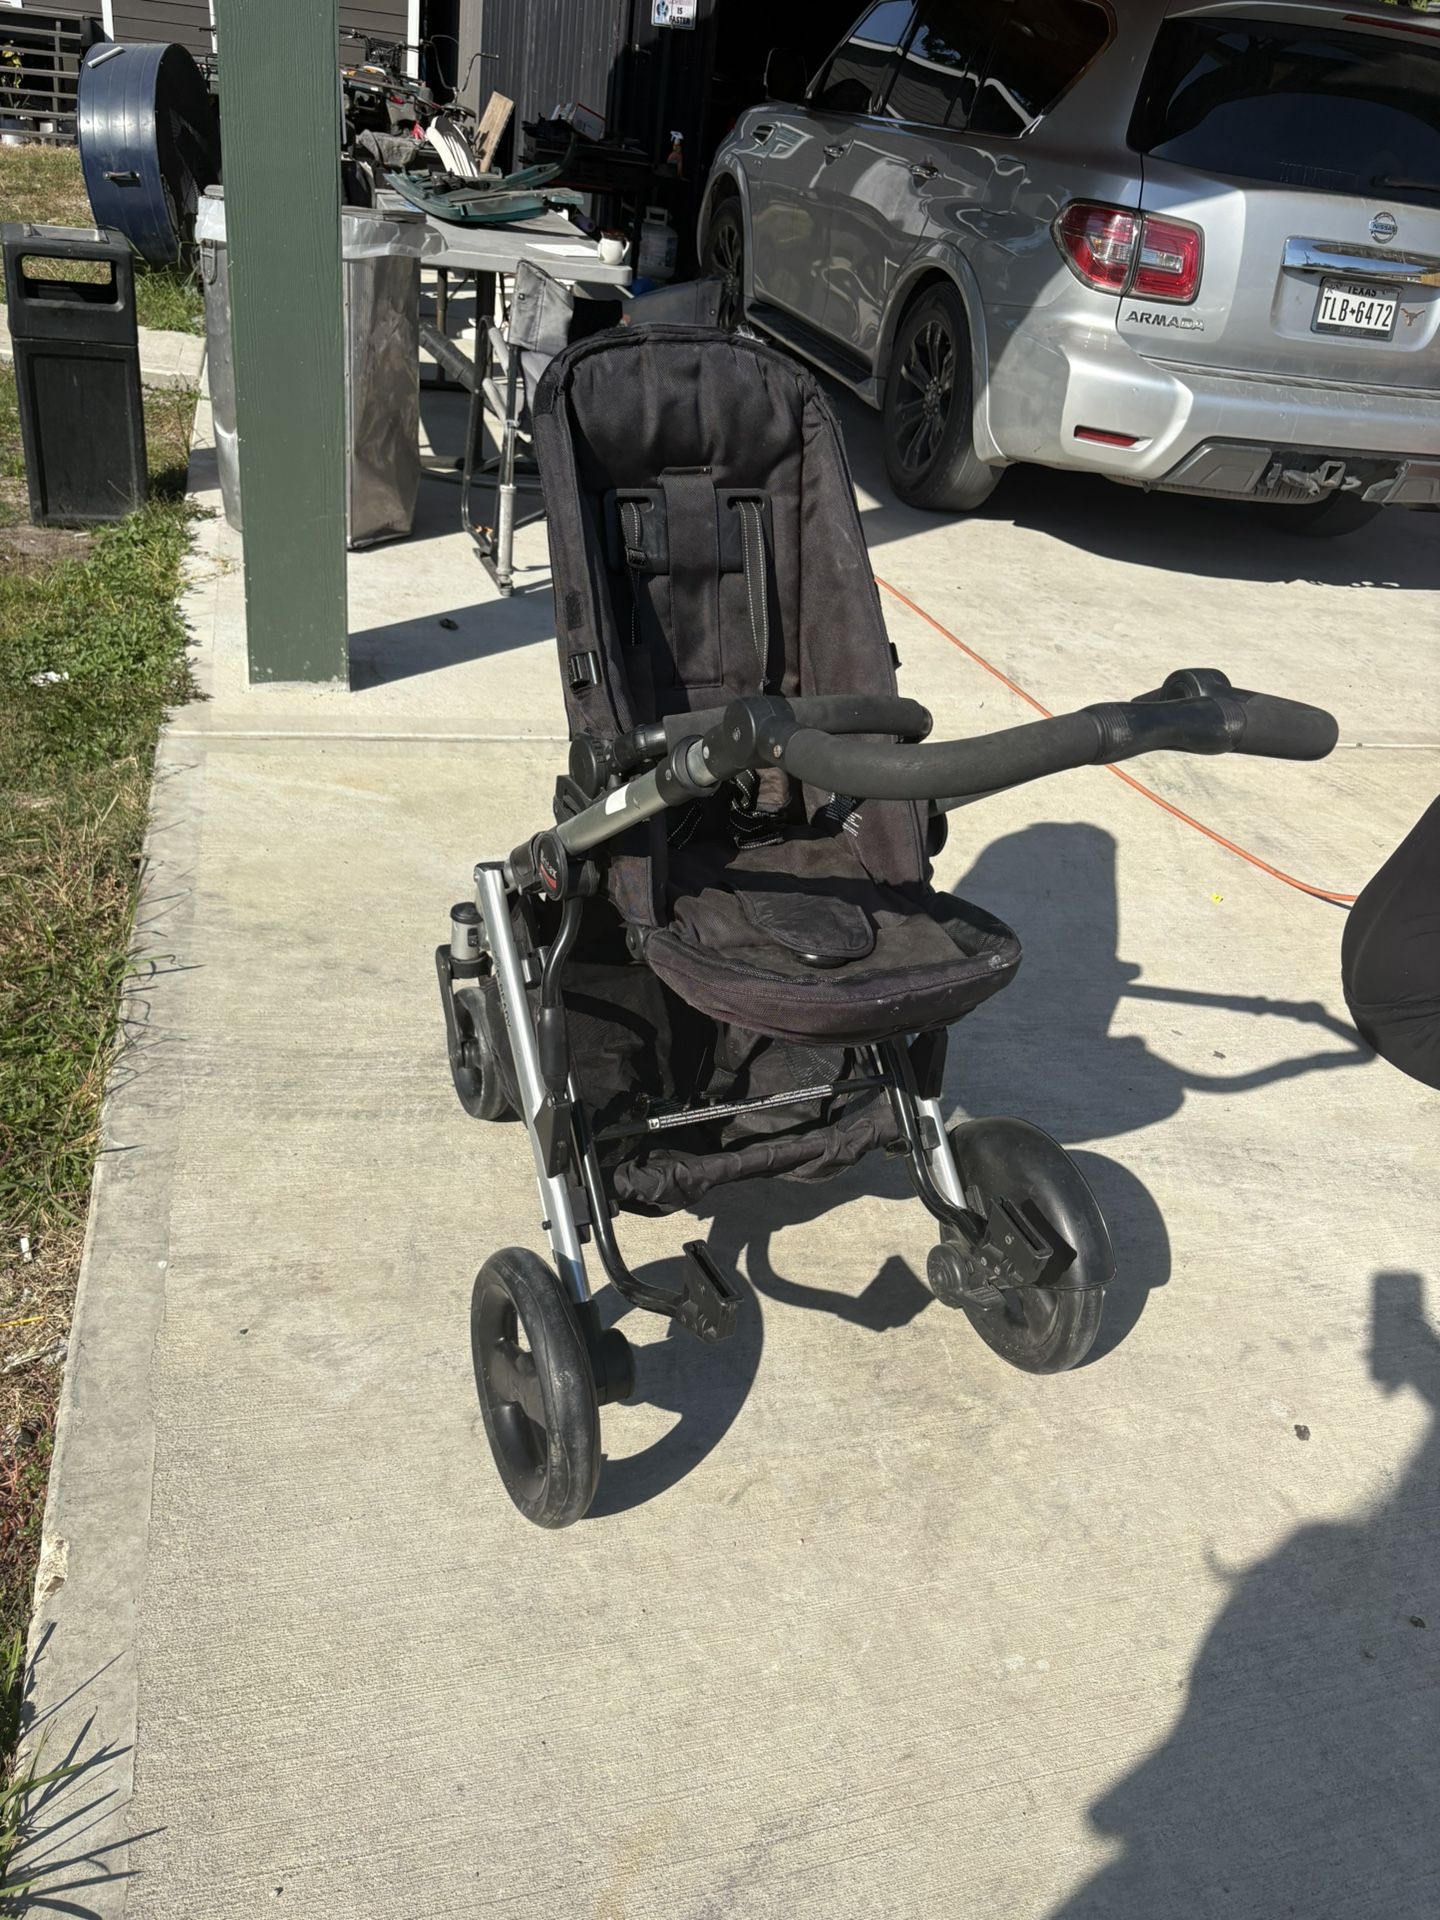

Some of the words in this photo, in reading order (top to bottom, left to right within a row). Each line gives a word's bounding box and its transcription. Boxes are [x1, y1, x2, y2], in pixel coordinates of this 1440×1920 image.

[669, 15, 690, 24] FASTER
[1347, 286, 1377, 298] TEXAS
[1125, 311, 1205, 331] ARMADA
